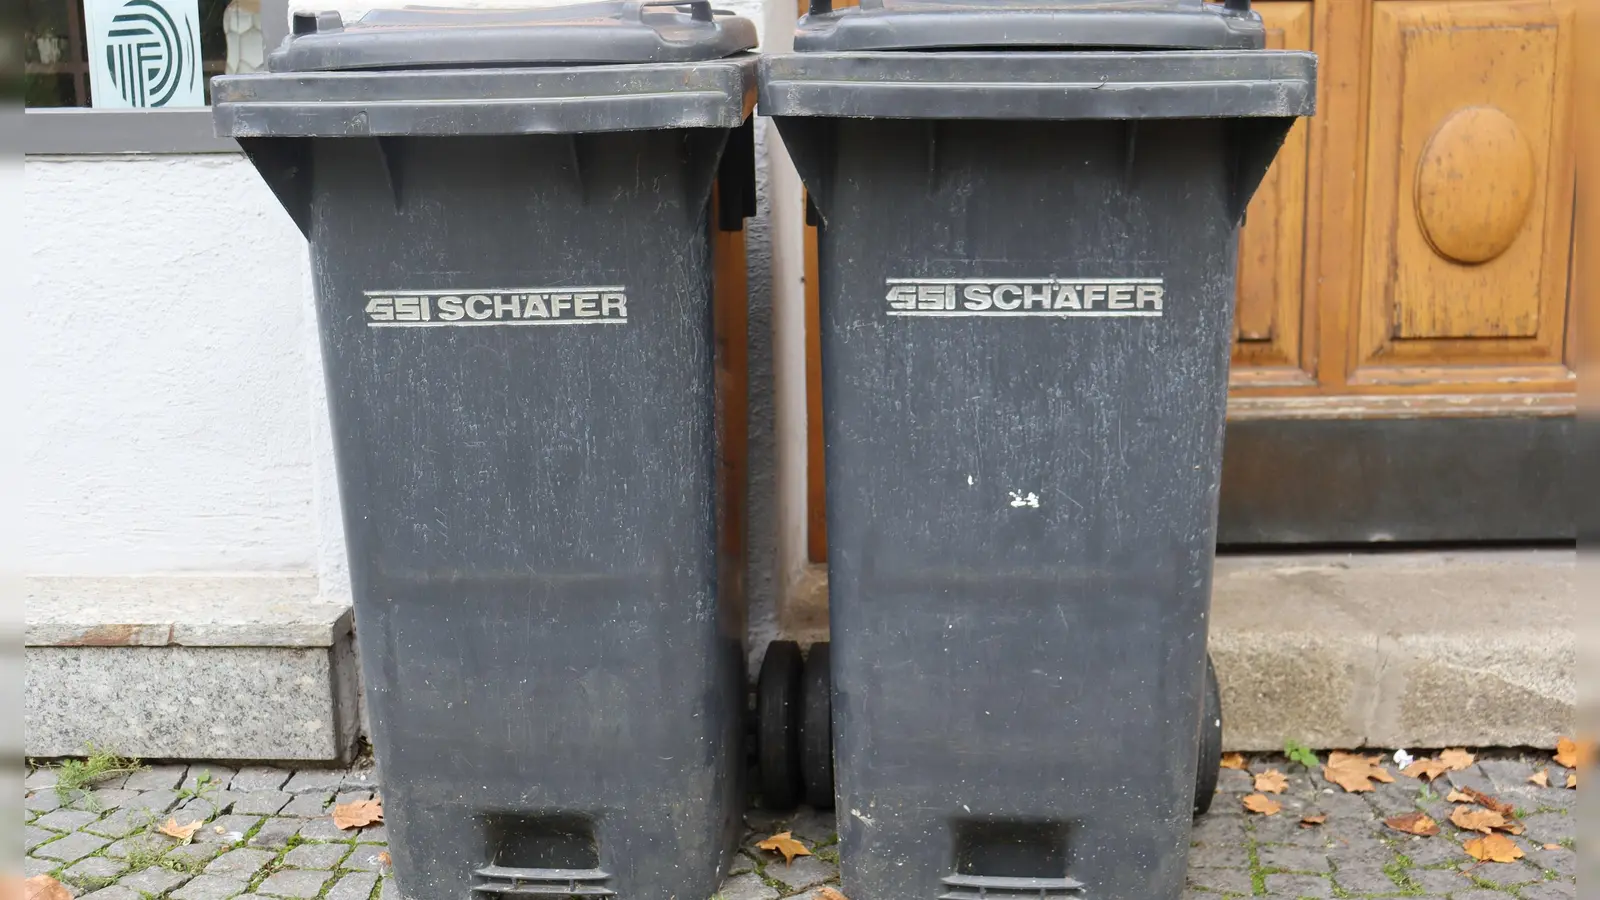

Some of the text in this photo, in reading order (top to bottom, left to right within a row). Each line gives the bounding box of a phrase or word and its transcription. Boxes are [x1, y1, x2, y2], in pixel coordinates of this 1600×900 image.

[365, 293, 628, 321] SSI SCHÄFER
[886, 284, 1164, 310] SSI SCHÄFER
